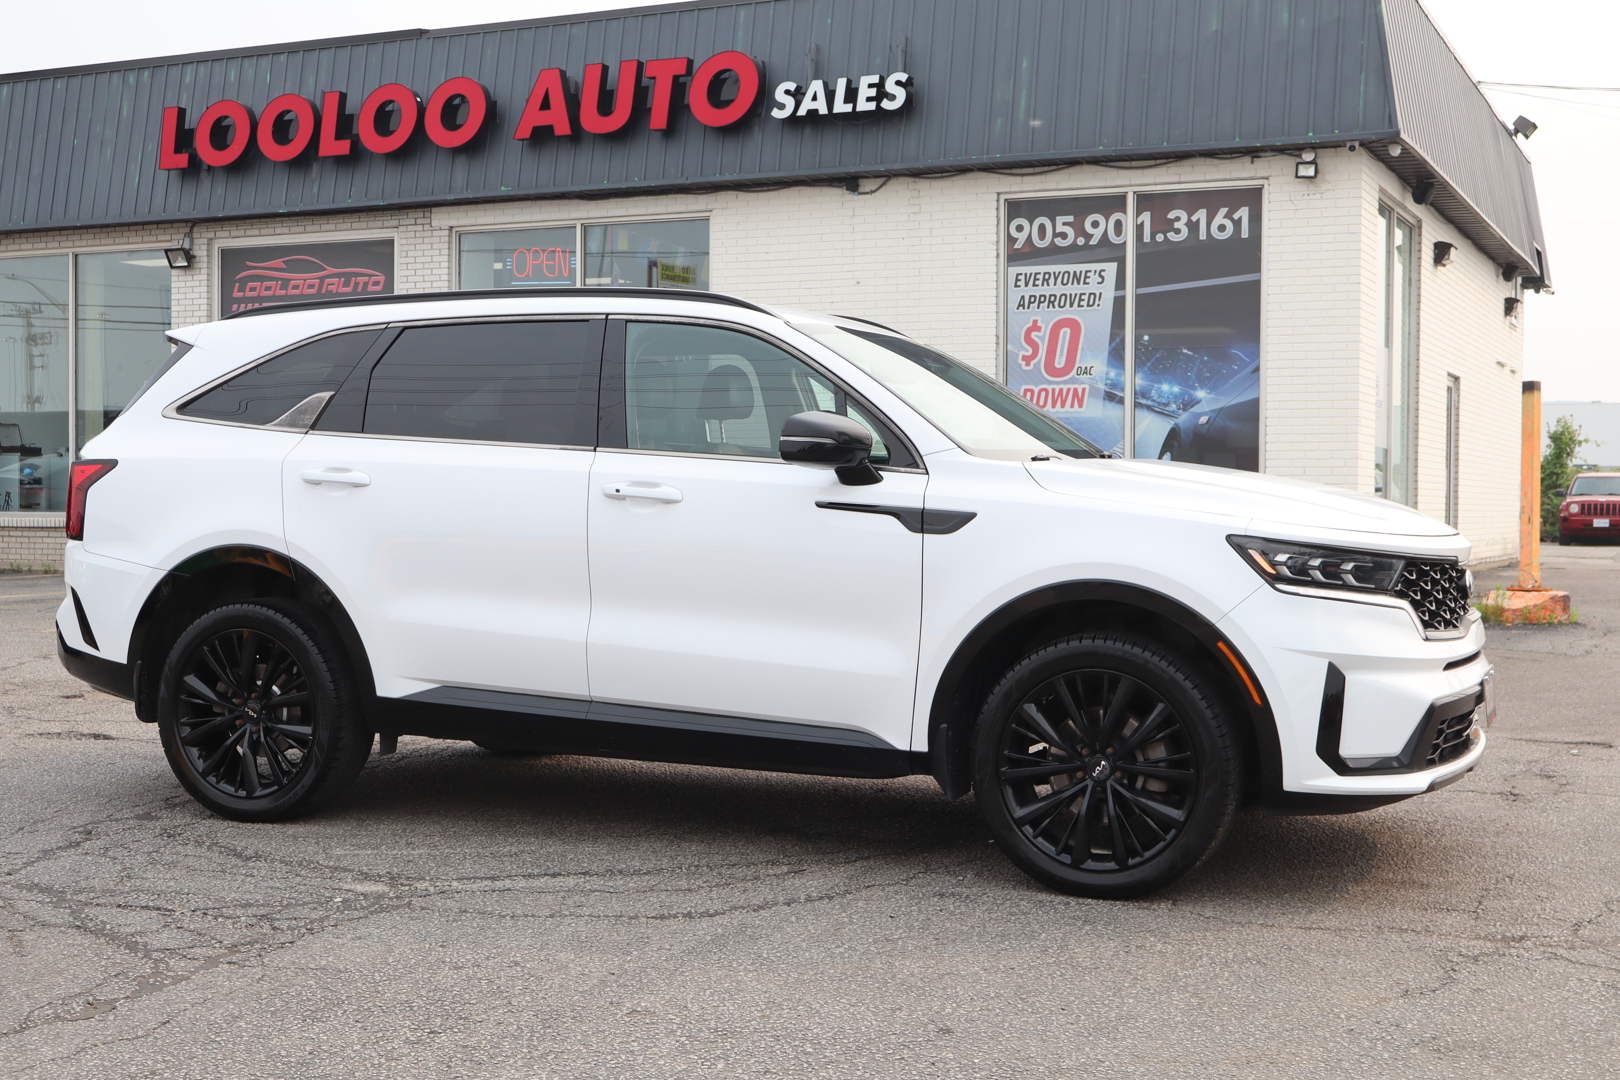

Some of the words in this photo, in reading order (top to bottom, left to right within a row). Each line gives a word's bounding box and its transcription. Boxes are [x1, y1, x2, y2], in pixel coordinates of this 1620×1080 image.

[159, 77, 487, 170] LOOLOO
[513, 51, 760, 141] AUTO
[770, 71, 910, 120] SALES
[1009, 206, 1250, 249] 905.901.3161
[513, 247, 570, 278] OPEN
[232, 279, 320, 298] LOOLOO
[321, 276, 386, 294] AUTO
[1013, 268, 1106, 289] EVERYONE'S
[1016, 291, 1103, 311] APPROVED!
[1021, 317, 1082, 378] $0
[1075, 365, 1095, 376] OAC
